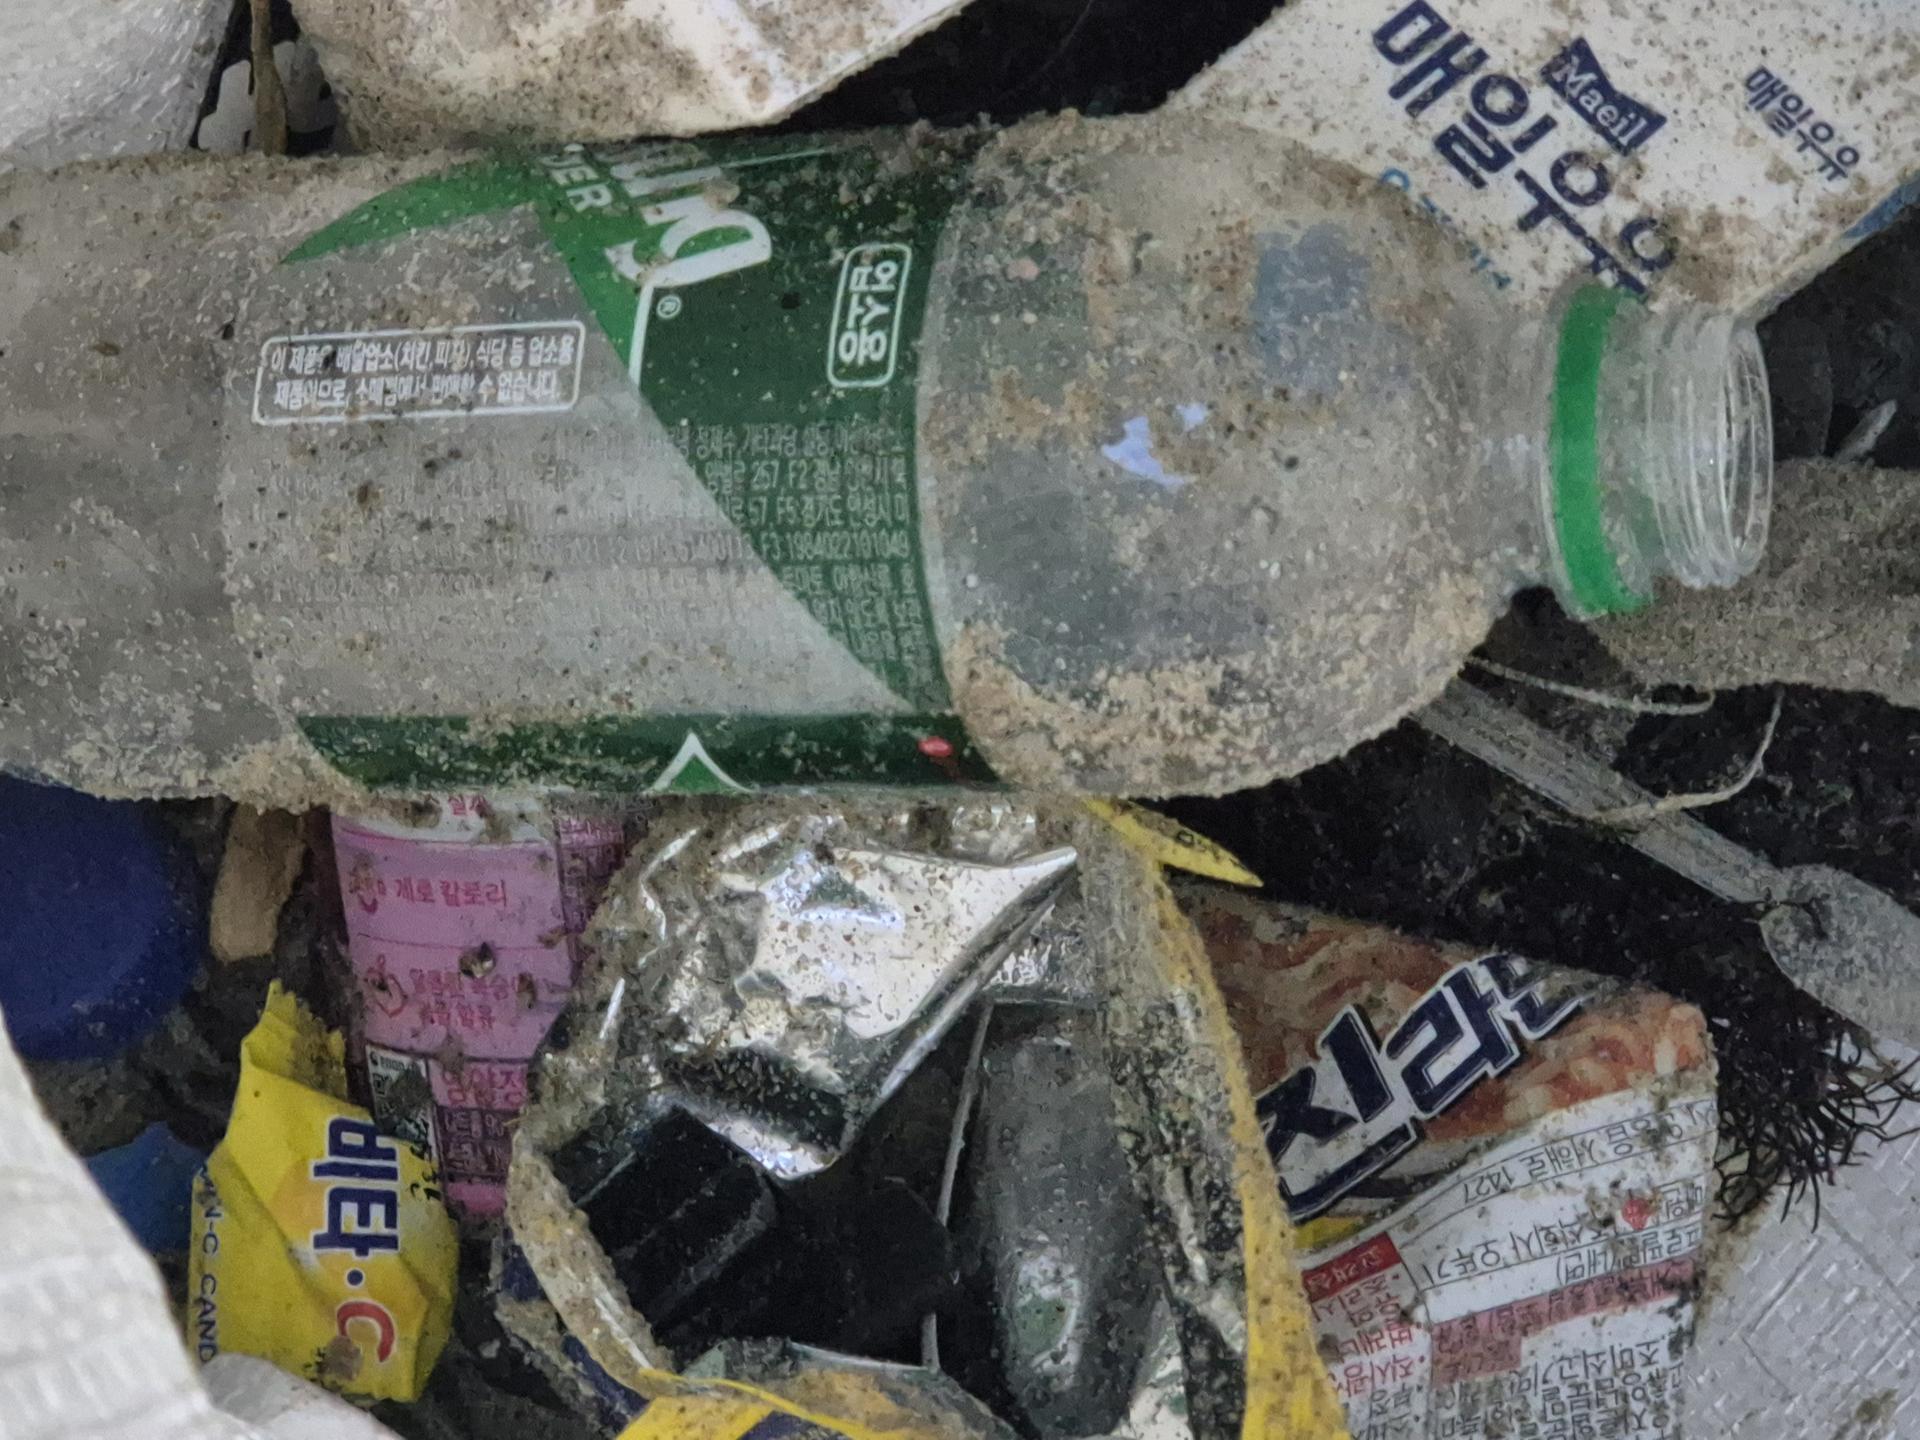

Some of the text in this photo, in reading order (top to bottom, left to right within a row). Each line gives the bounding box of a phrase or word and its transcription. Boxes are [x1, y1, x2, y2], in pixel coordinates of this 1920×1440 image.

[1551, 55, 1650, 145] Maeil
[1744, 66, 1860, 183] 매일우유
[838, 260, 899, 367] 업소용
[271, 346, 287, 375] 이
[510, 336, 525, 369] 등
[529, 334, 575, 368] 업소용
[1519, 1135, 1600, 1184] 서해로
[1463, 1166, 1515, 1204] 1427
[1422, 1238, 1502, 1285] 오뚜기
